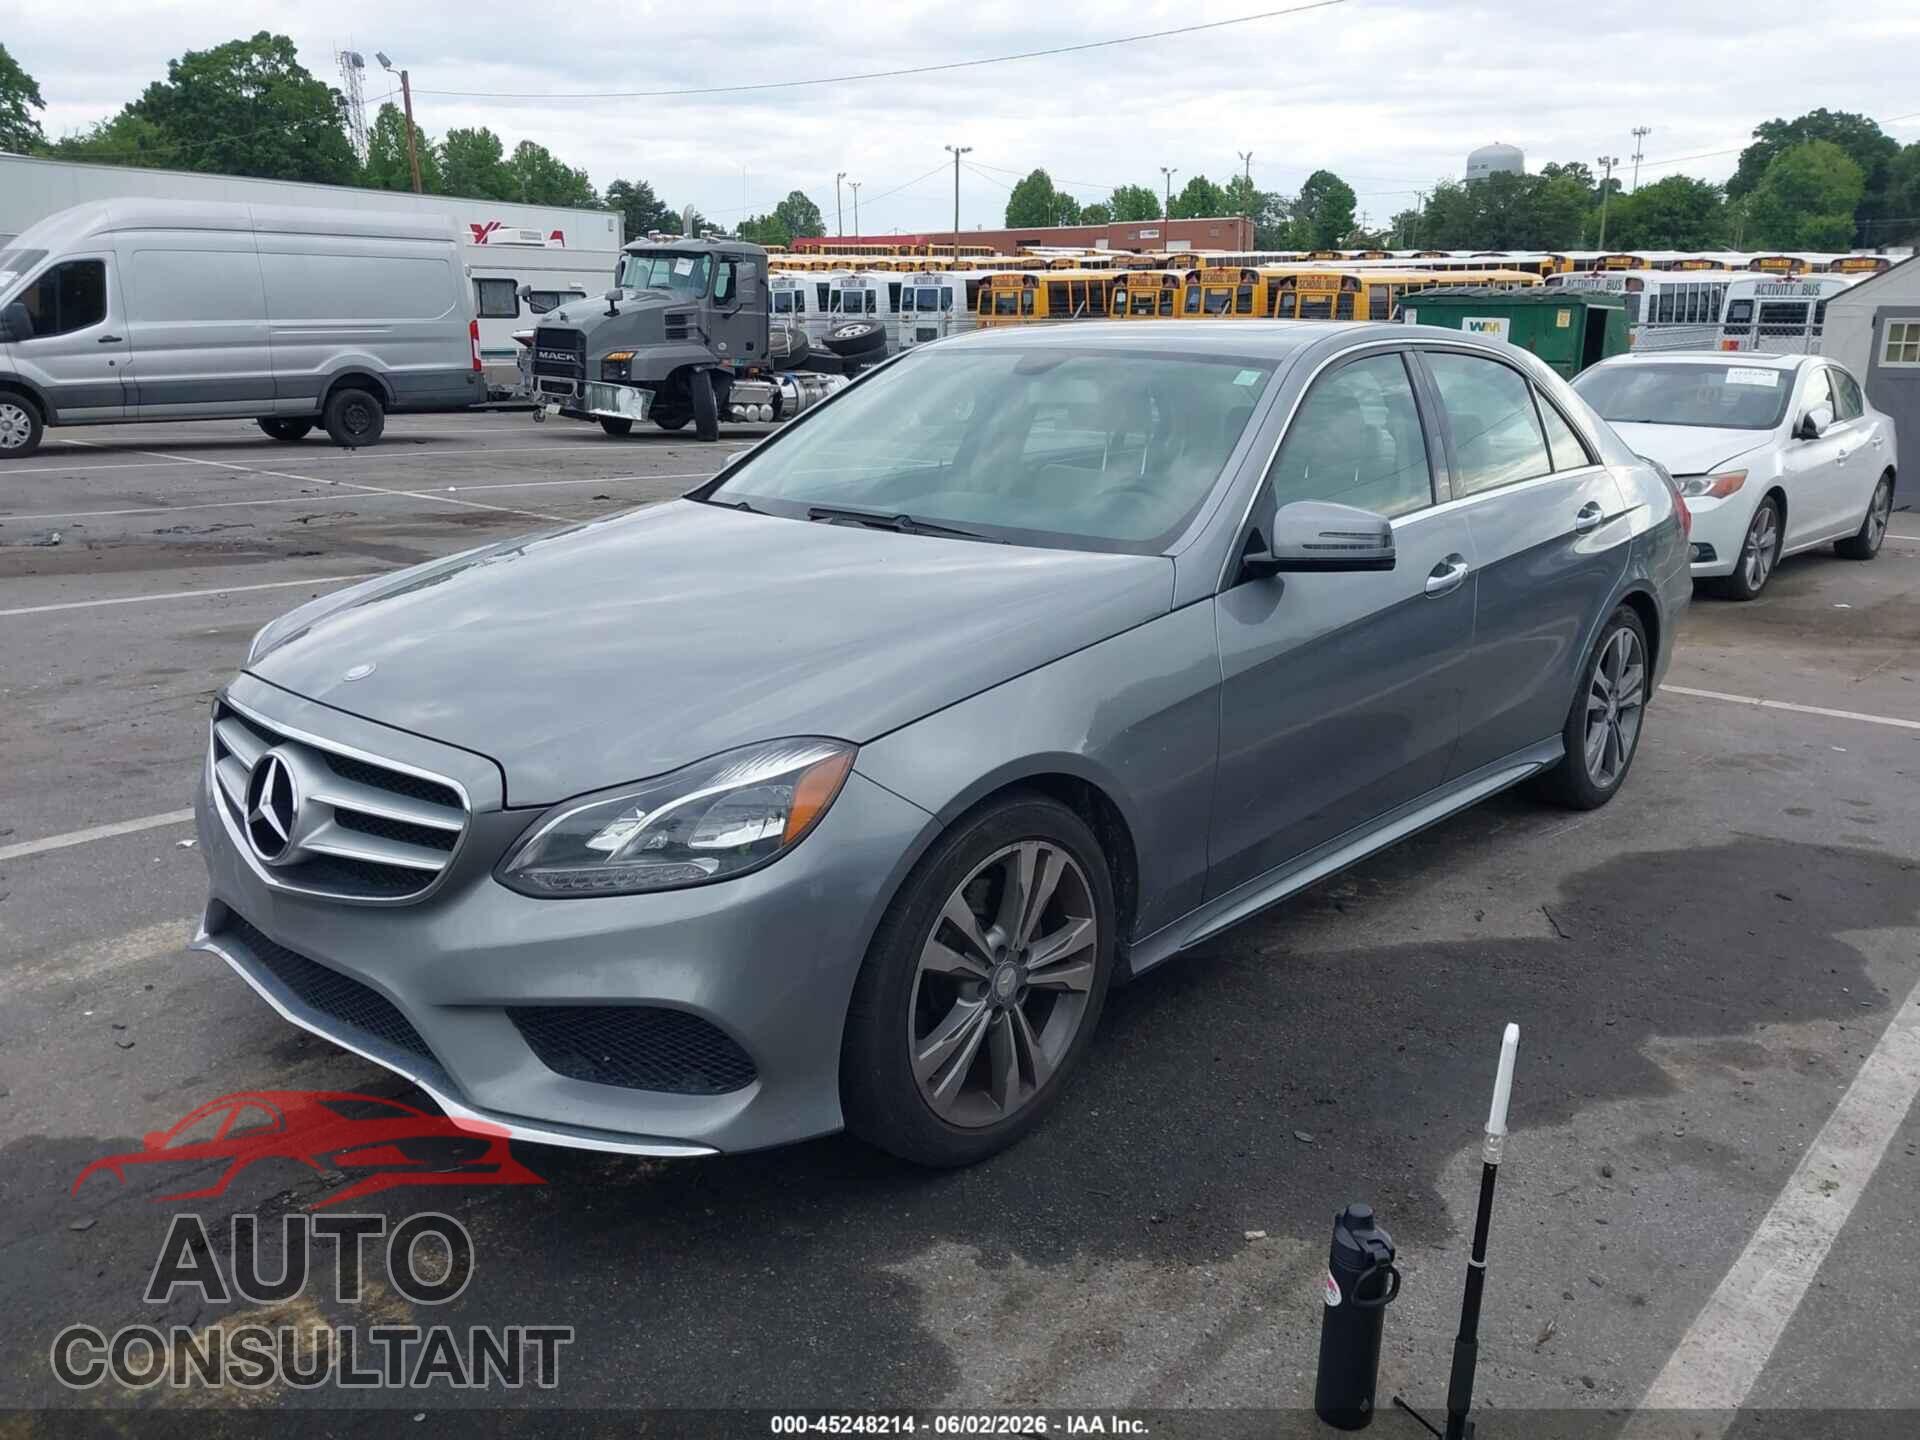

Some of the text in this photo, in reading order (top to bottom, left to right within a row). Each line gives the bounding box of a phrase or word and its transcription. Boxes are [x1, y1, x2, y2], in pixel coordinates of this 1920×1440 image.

[1566, 279, 1622, 290] ACTIVITY BUS
[1753, 283, 1821, 296] ACTIVITY BUS
[1469, 320, 1500, 333] WM
[538, 351, 577, 362] MACK
